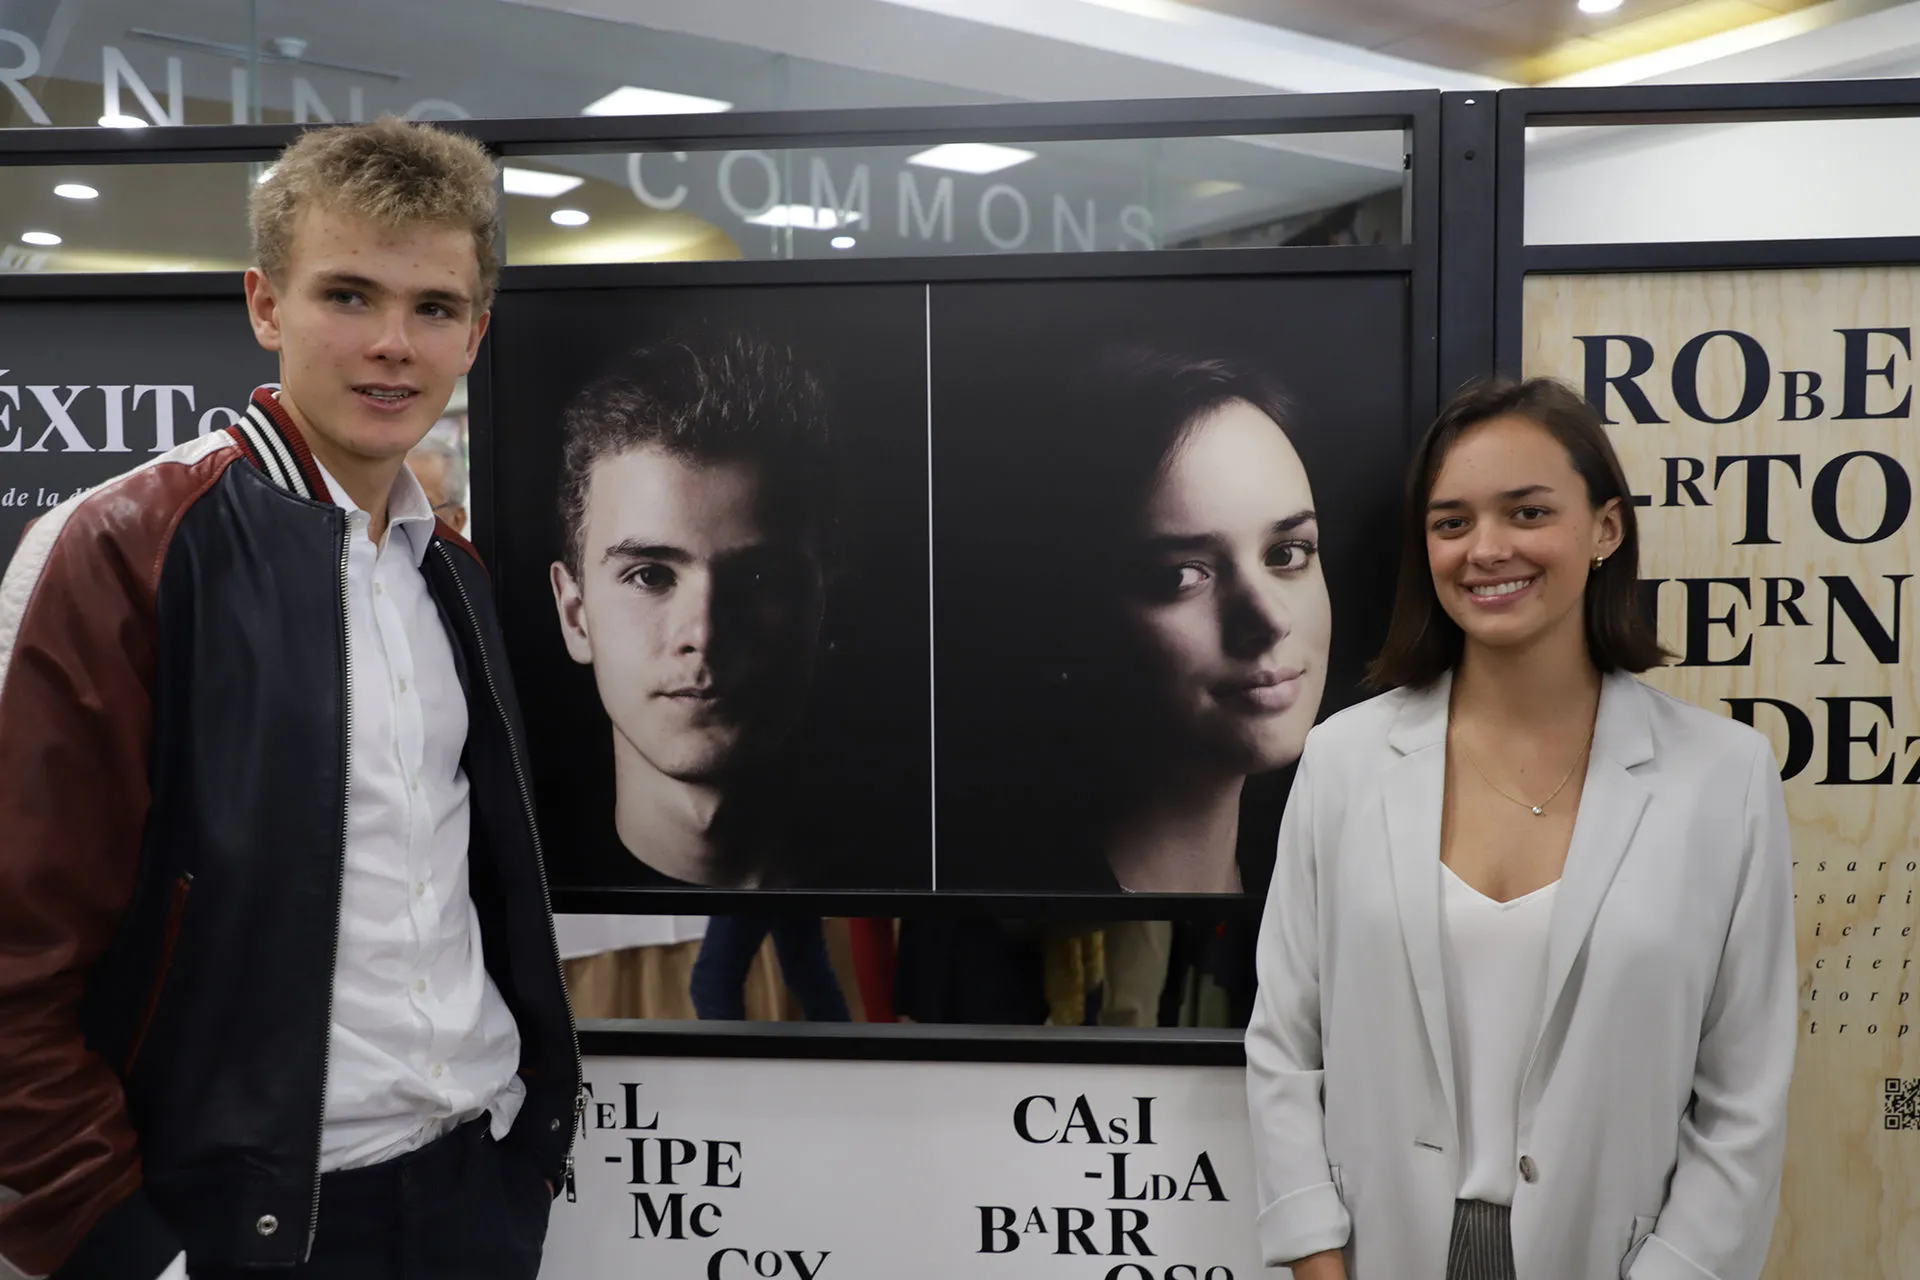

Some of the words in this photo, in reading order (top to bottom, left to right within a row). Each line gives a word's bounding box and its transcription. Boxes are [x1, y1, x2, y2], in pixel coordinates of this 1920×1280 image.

[0, 28, 472, 126] RNIN
[627, 150, 1155, 251] COMMONS
[1, 487, 29, 507] de
[36, 487, 60, 507] la
[604, 1137, 743, 1189] -IPE
